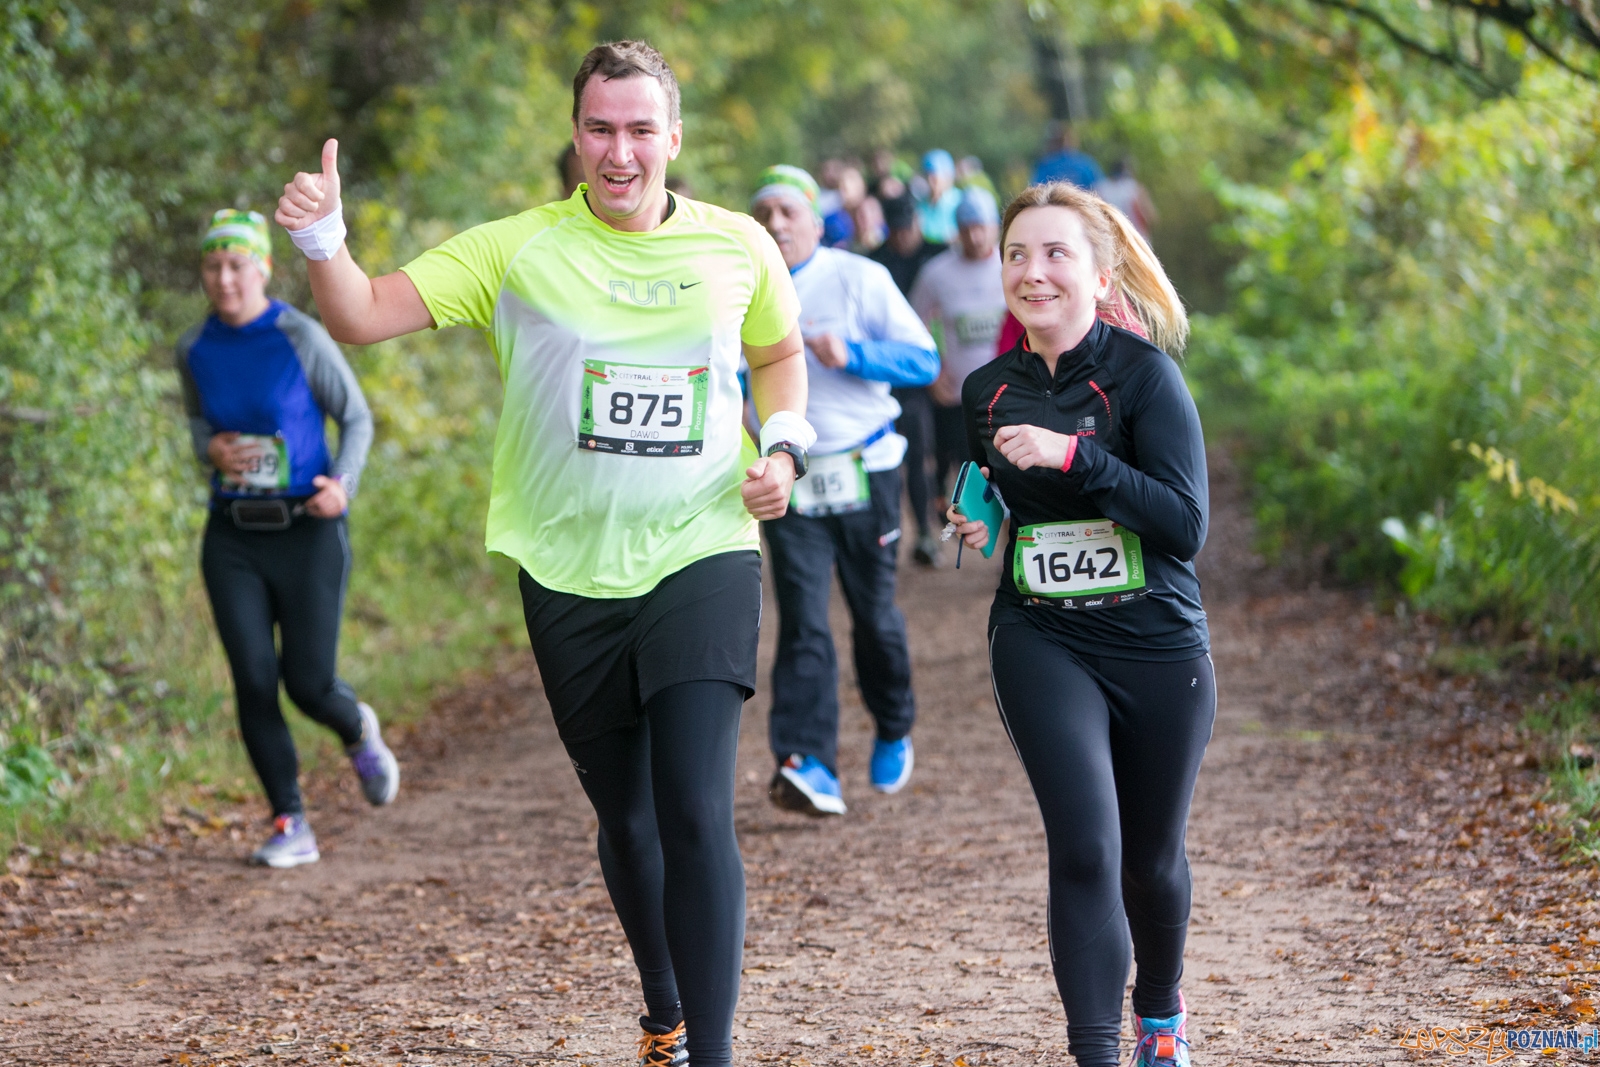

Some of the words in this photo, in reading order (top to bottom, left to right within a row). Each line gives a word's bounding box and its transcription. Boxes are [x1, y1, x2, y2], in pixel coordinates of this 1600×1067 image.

[609, 391, 683, 427] 875
[630, 429, 660, 440] DAWID
[1032, 547, 1121, 584] 1642
[1132, 550, 1140, 580] Poznań
